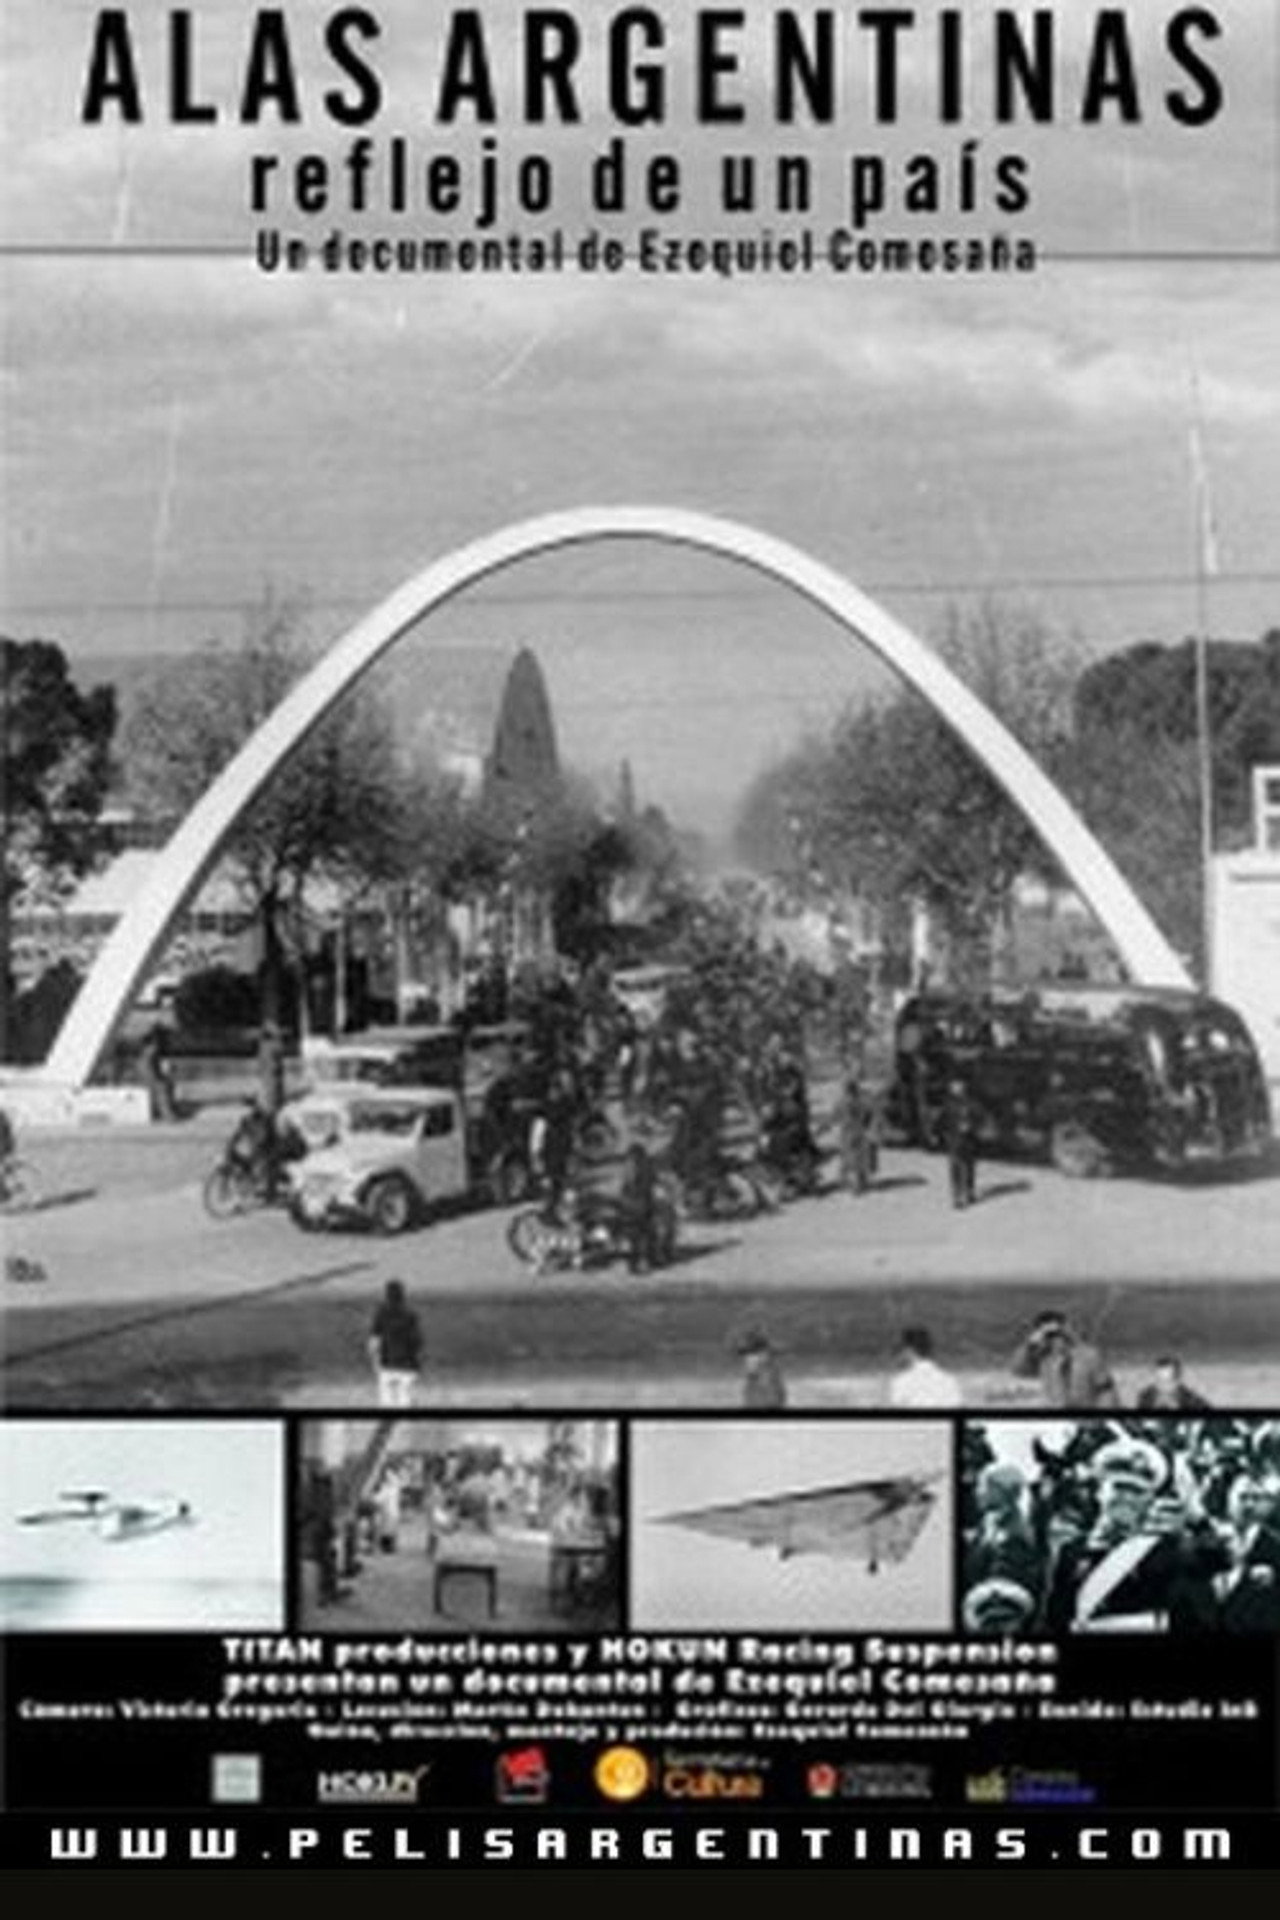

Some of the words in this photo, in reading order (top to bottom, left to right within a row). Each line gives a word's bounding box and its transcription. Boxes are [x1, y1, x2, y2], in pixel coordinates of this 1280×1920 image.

[82, 7, 383, 126] ALAS
[436, 6, 1225, 127] ARGENTINAS
[250, 138, 553, 229] reflejo
[592, 137, 681, 214] de
[721, 155, 811, 213] un
[851, 140, 1030, 230] país
[256, 229, 306, 272] Un
[322, 229, 564, 272] documental
[578, 229, 624, 272] de
[639, 229, 813, 275] Ezequiel
[222, 1638, 323, 1663] TITAN
[334, 1636, 559, 1668] producciones
[568, 1644, 589, 1668] y
[738, 1637, 856, 1668] Racing
[224, 1669, 400, 1699] presentan
[409, 1673, 452, 1694] un
[463, 1668, 662, 1694] documental
[673, 1668, 714, 1694] de
[726, 1667, 872, 1699] Ezequiel
